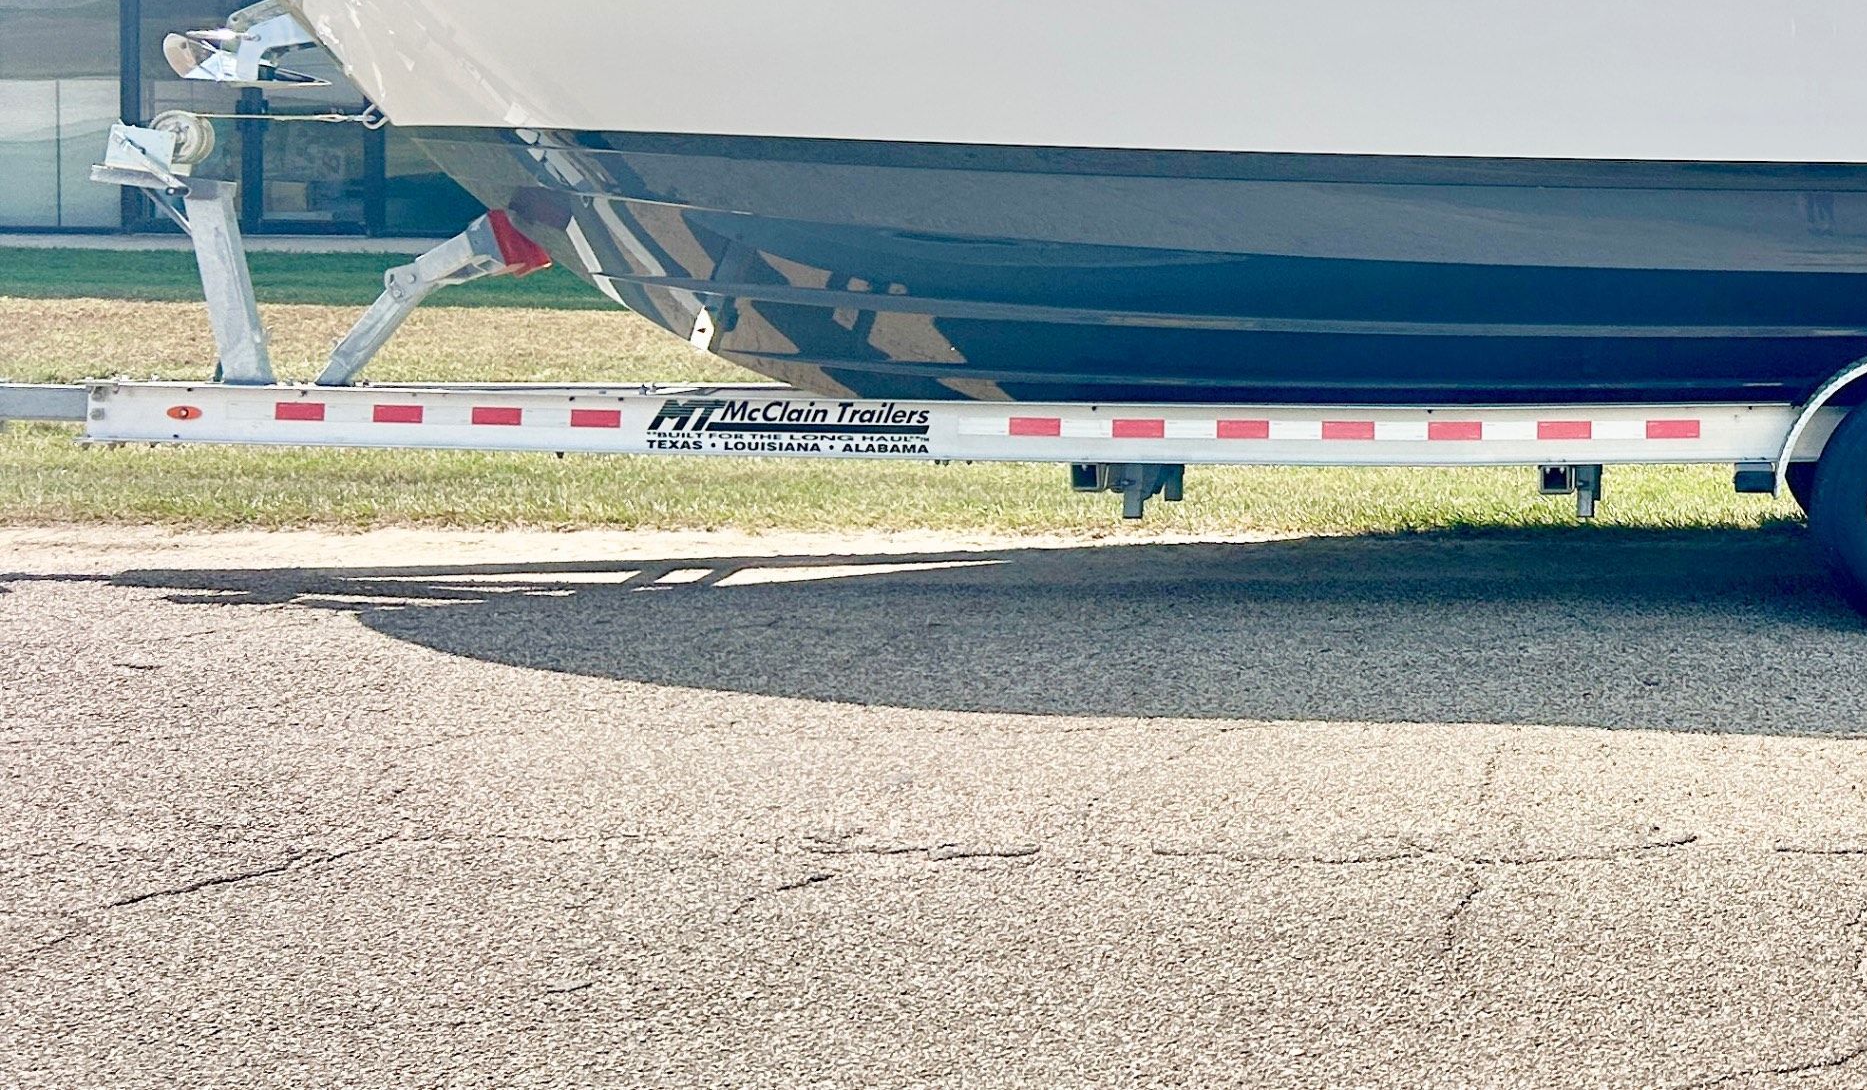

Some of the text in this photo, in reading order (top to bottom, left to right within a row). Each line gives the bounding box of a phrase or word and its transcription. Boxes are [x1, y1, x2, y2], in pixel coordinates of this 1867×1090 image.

[720, 400, 829, 422] McClain
[837, 402, 930, 424] Trailers
[646, 439, 929, 454] TEXAS LOUISIANA ALABAMA
